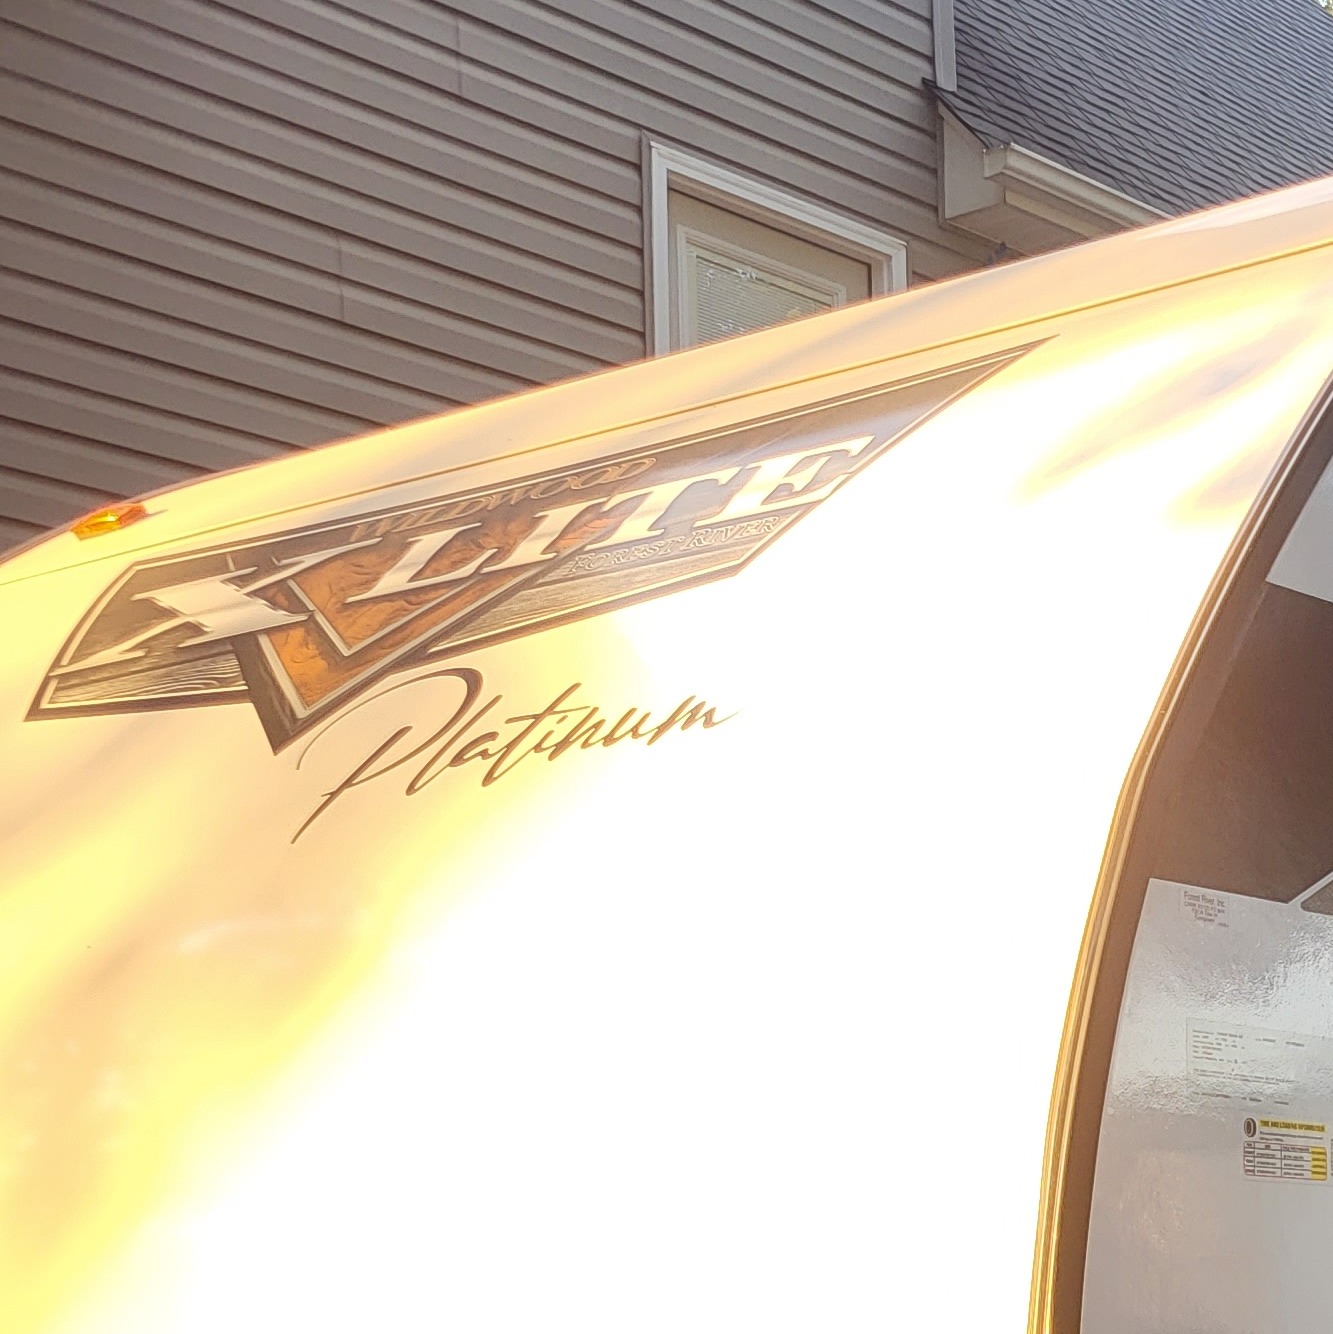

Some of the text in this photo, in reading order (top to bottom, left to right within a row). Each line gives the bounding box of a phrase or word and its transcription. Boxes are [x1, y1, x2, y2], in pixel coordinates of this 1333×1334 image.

[351, 457, 656, 541] WILDWOOD
[566, 516, 781, 575] FOREST RIVER
[291, 667, 738, 845] Platinum
